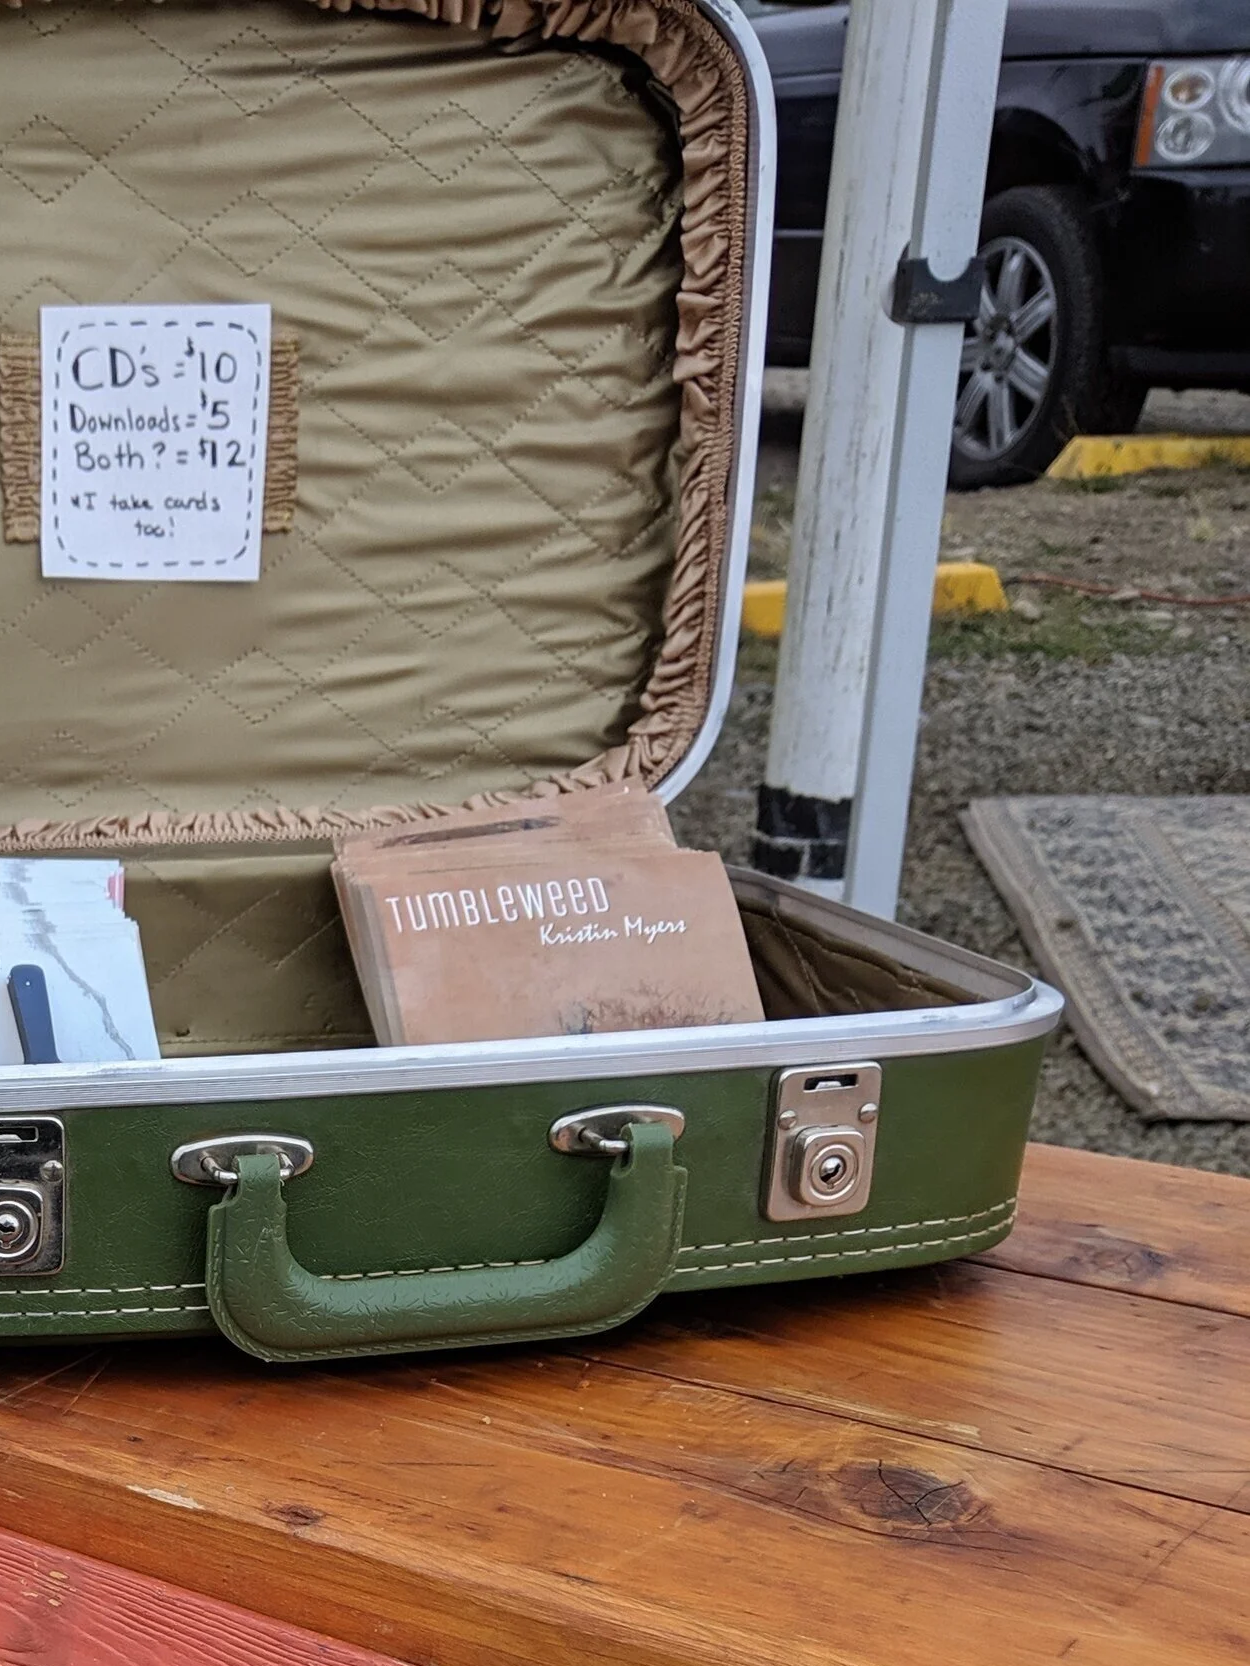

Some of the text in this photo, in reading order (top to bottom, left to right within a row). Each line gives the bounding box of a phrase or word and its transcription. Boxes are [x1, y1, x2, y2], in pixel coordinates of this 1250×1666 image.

[72, 345, 160, 391] CD's
[69, 403, 181, 433] Downloads
[110, 493, 153, 511] take
[164, 491, 221, 512] cards
[134, 516, 175, 538] too!
[540, 915, 687, 946] Kristin Myers
